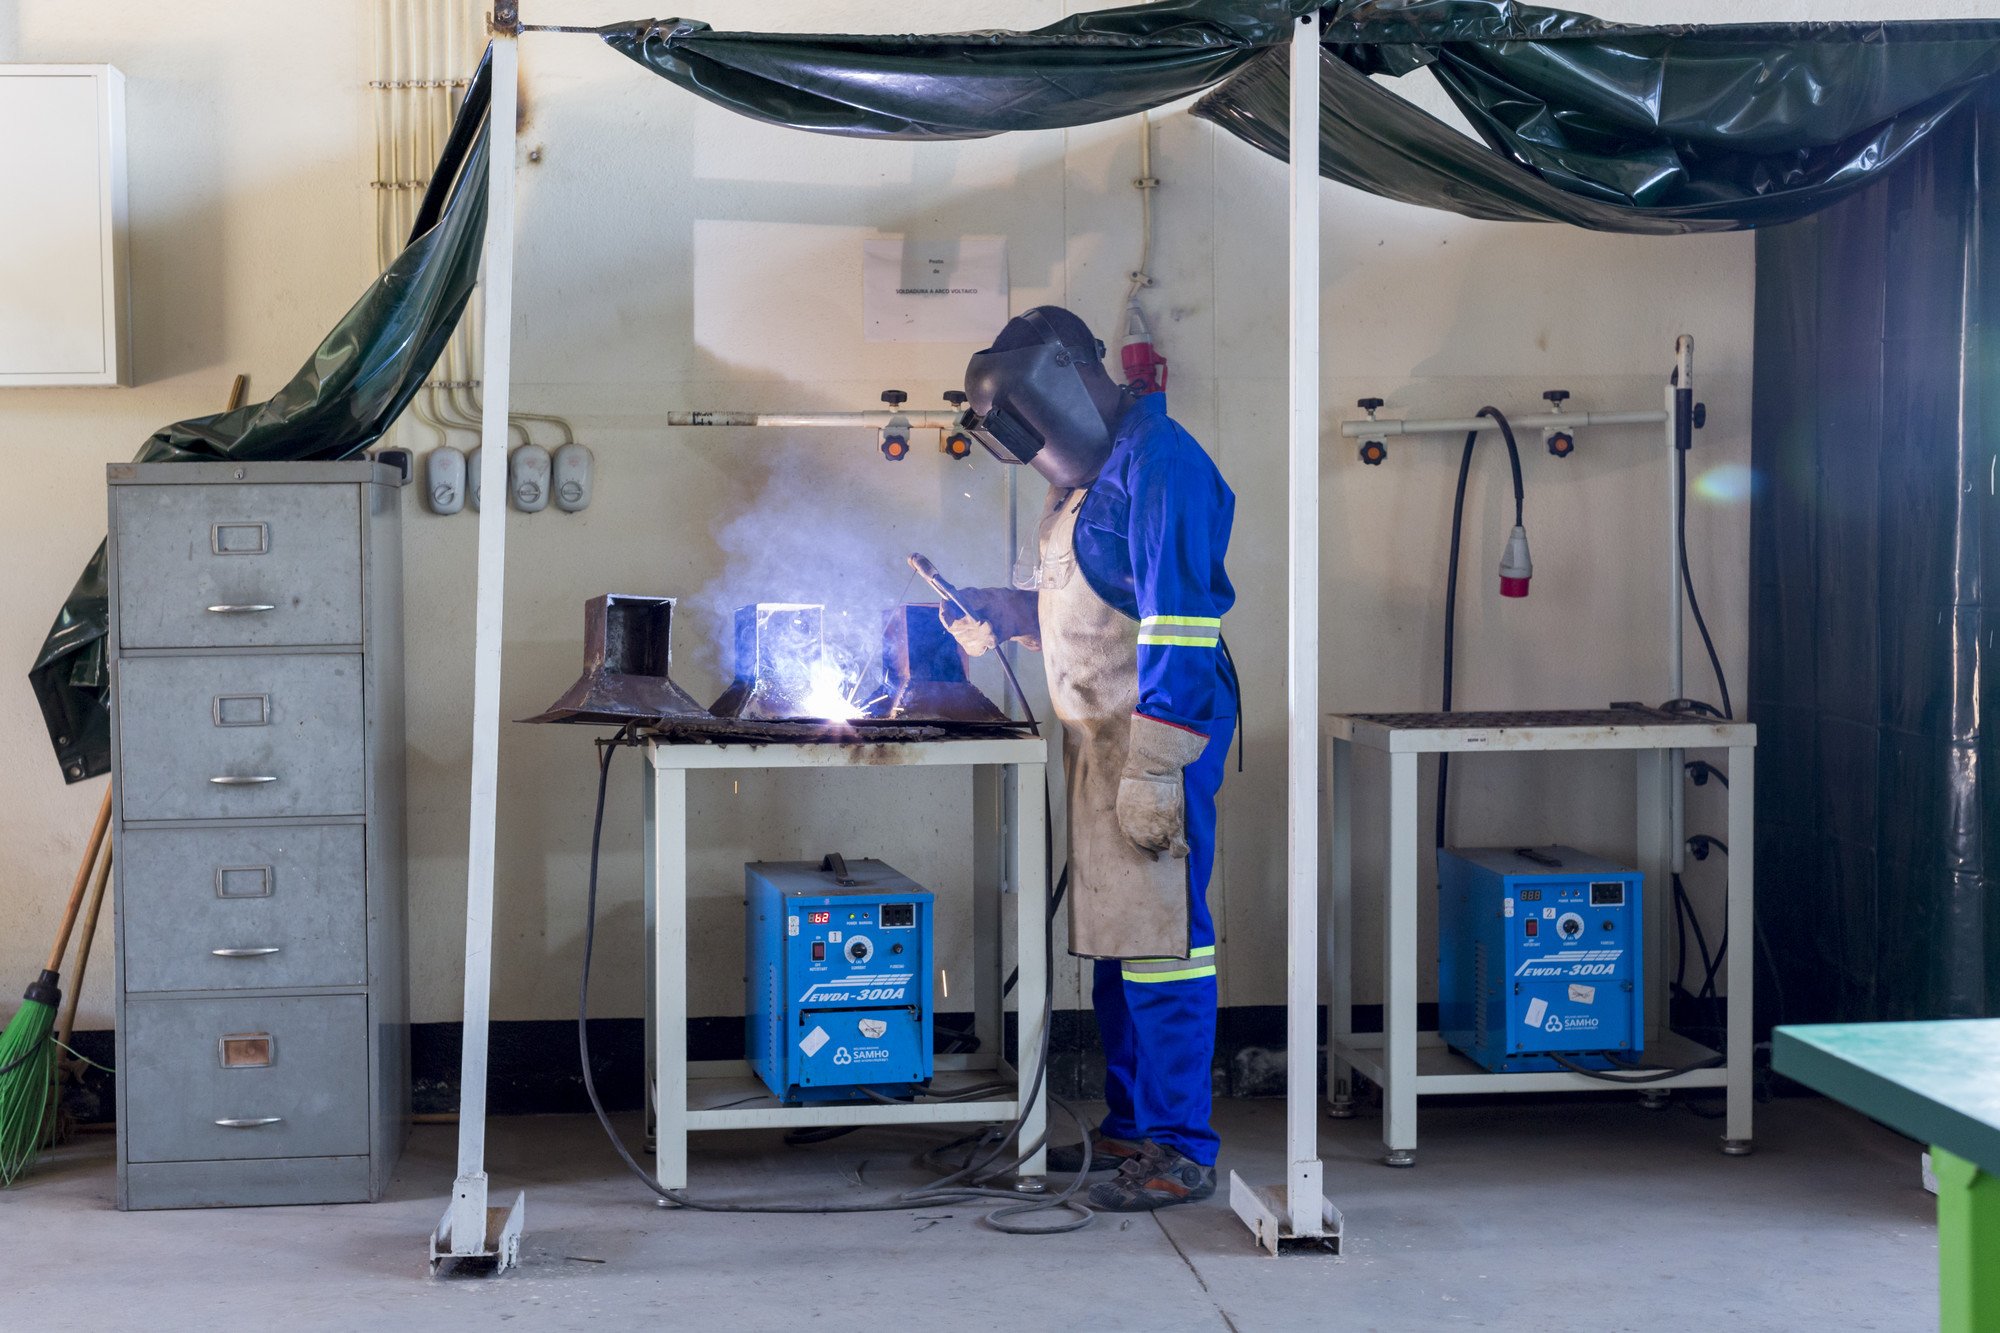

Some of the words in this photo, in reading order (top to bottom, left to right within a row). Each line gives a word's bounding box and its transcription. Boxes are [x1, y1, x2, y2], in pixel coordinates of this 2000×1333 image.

[1546, 908, 1553, 918] 2
[1565, 1018, 1599, 1027] SAMHO
[853, 1050, 889, 1059] SAMHO
